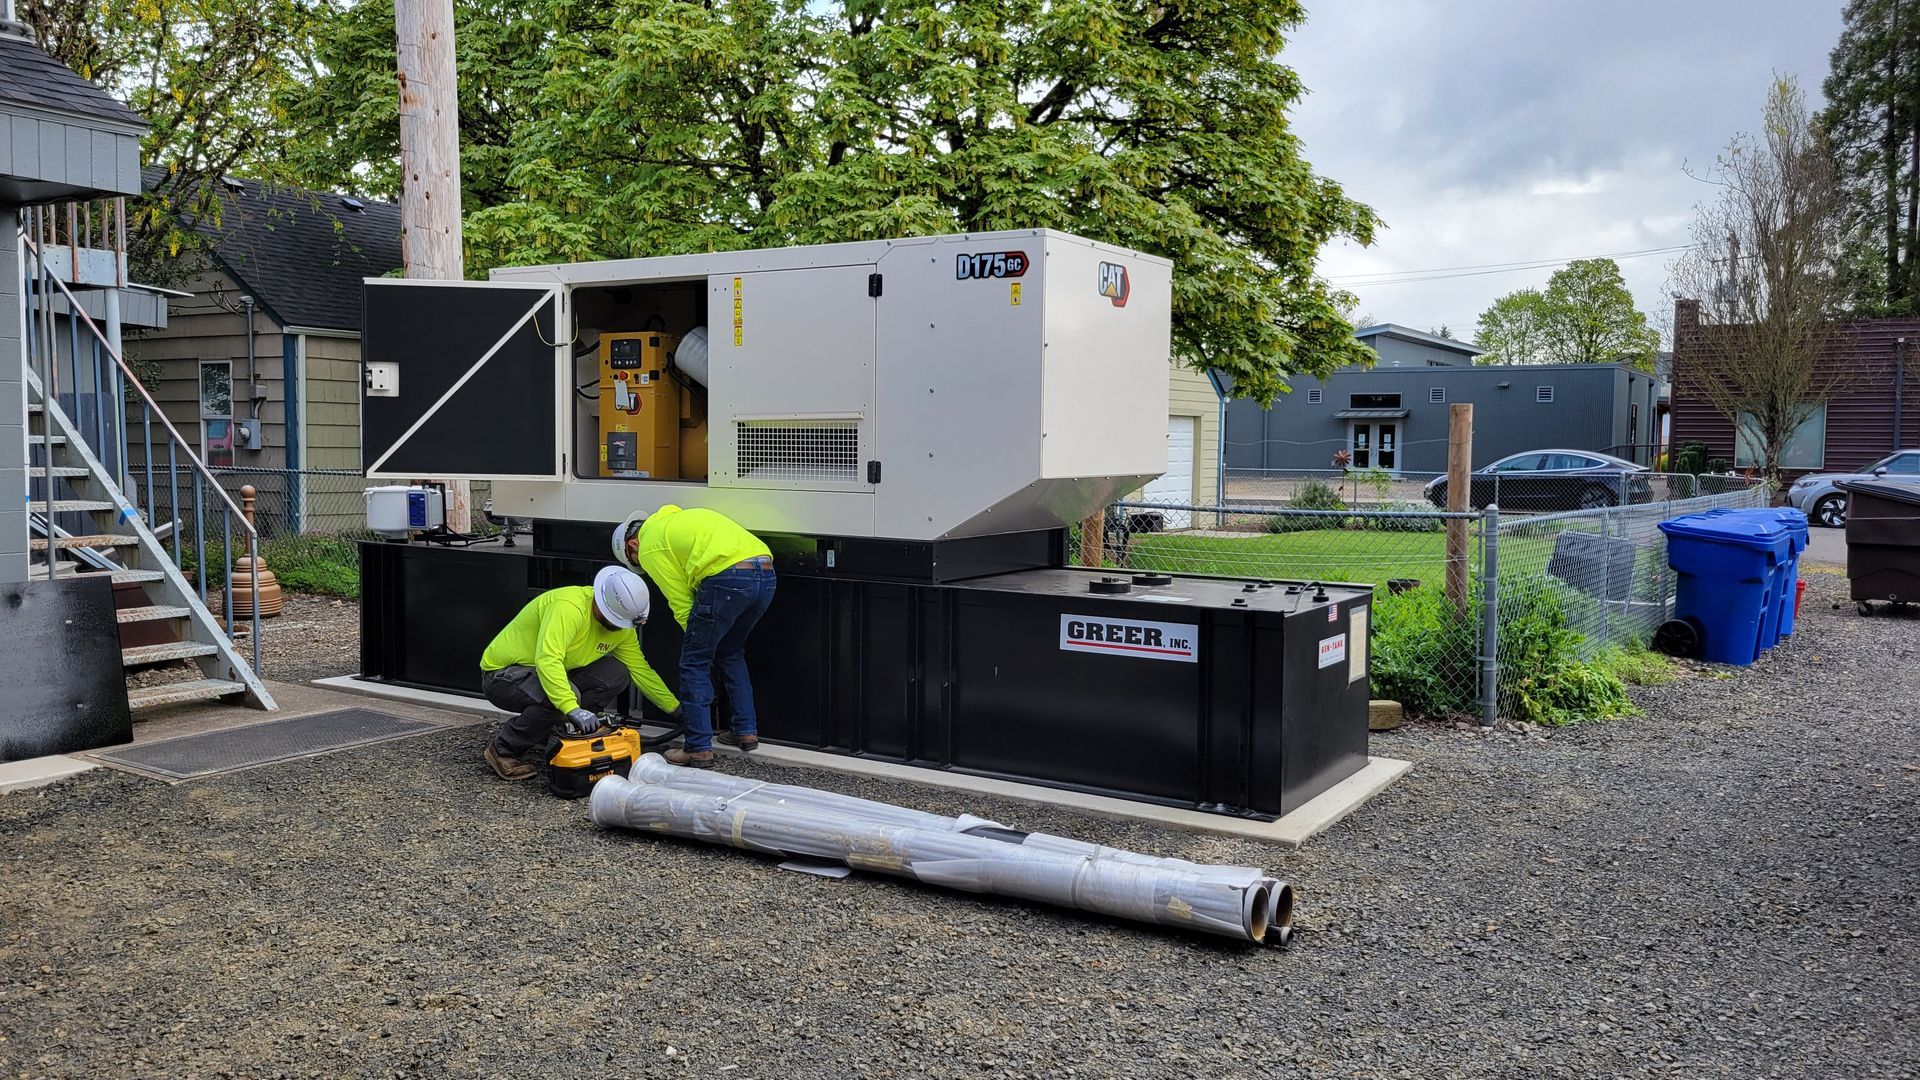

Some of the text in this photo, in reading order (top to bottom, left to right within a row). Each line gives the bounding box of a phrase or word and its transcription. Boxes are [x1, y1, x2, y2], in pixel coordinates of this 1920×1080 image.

[957, 253, 1022, 279] D175 GC
[1100, 262, 1125, 298] CAT
[1169, 637, 1192, 650] INC.
